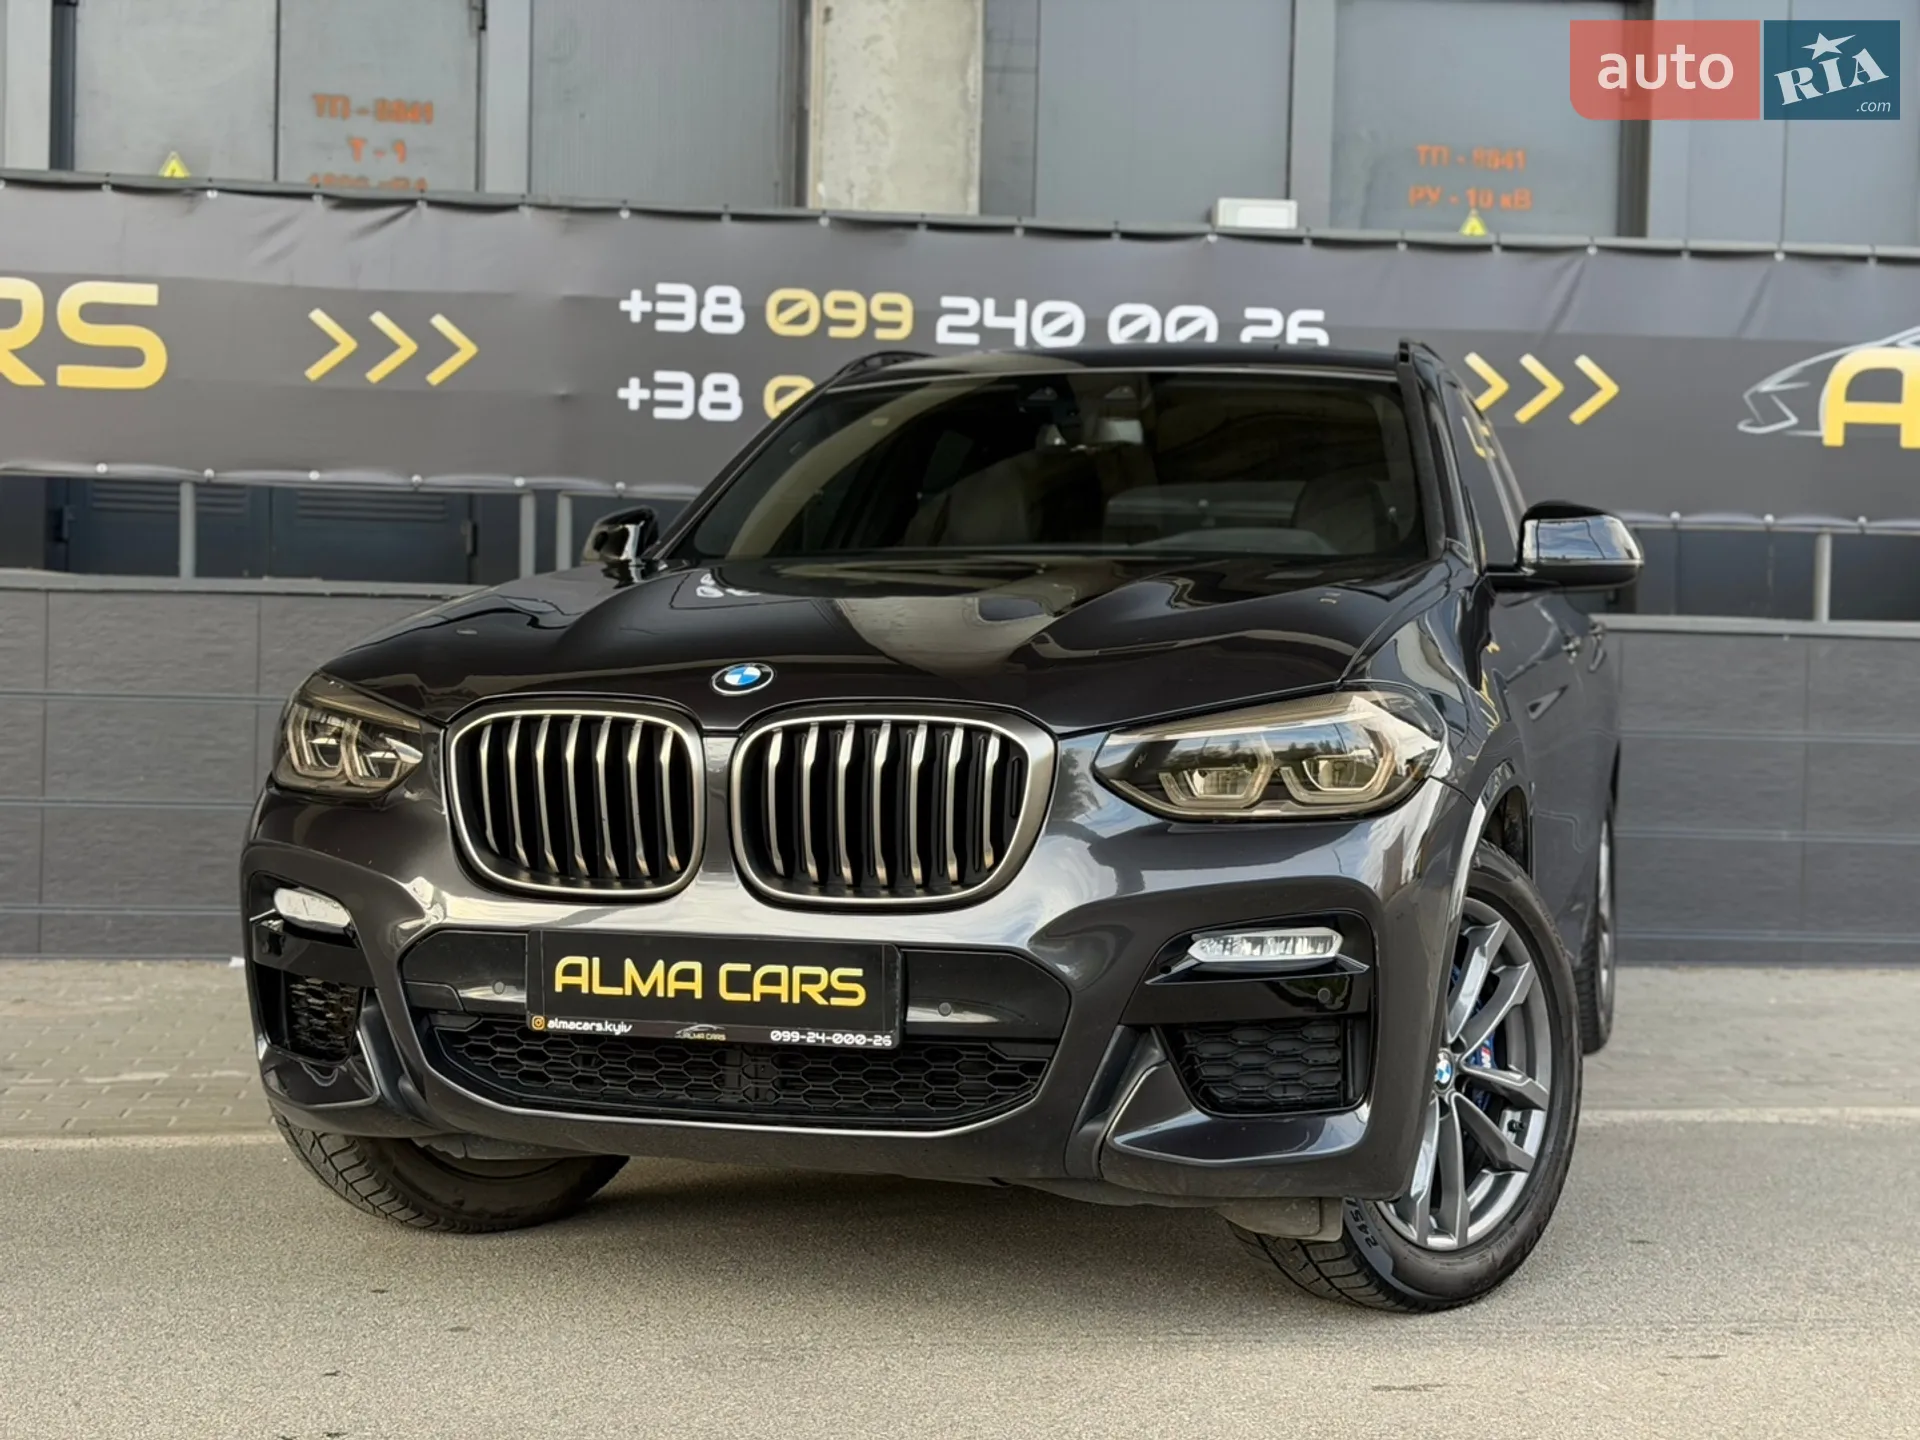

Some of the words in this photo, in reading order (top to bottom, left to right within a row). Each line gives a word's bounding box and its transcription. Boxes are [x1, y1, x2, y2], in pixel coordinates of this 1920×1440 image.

[1465, 187, 1495, 211] 10
[619, 282, 745, 335] +38
[765, 287, 914, 341] 099
[936, 295, 1086, 348] 240
[1107, 302, 1219, 343] 00
[1239, 306, 1330, 346] 26
[617, 370, 744, 422] +38
[1819, 346, 1920, 449] A
[554, 955, 703, 1000] ALMA
[718, 962, 867, 1008] CARS
[547, 1017, 633, 1036] almacars.kyiv
[770, 1029, 893, 1047] 099-24-000-26
